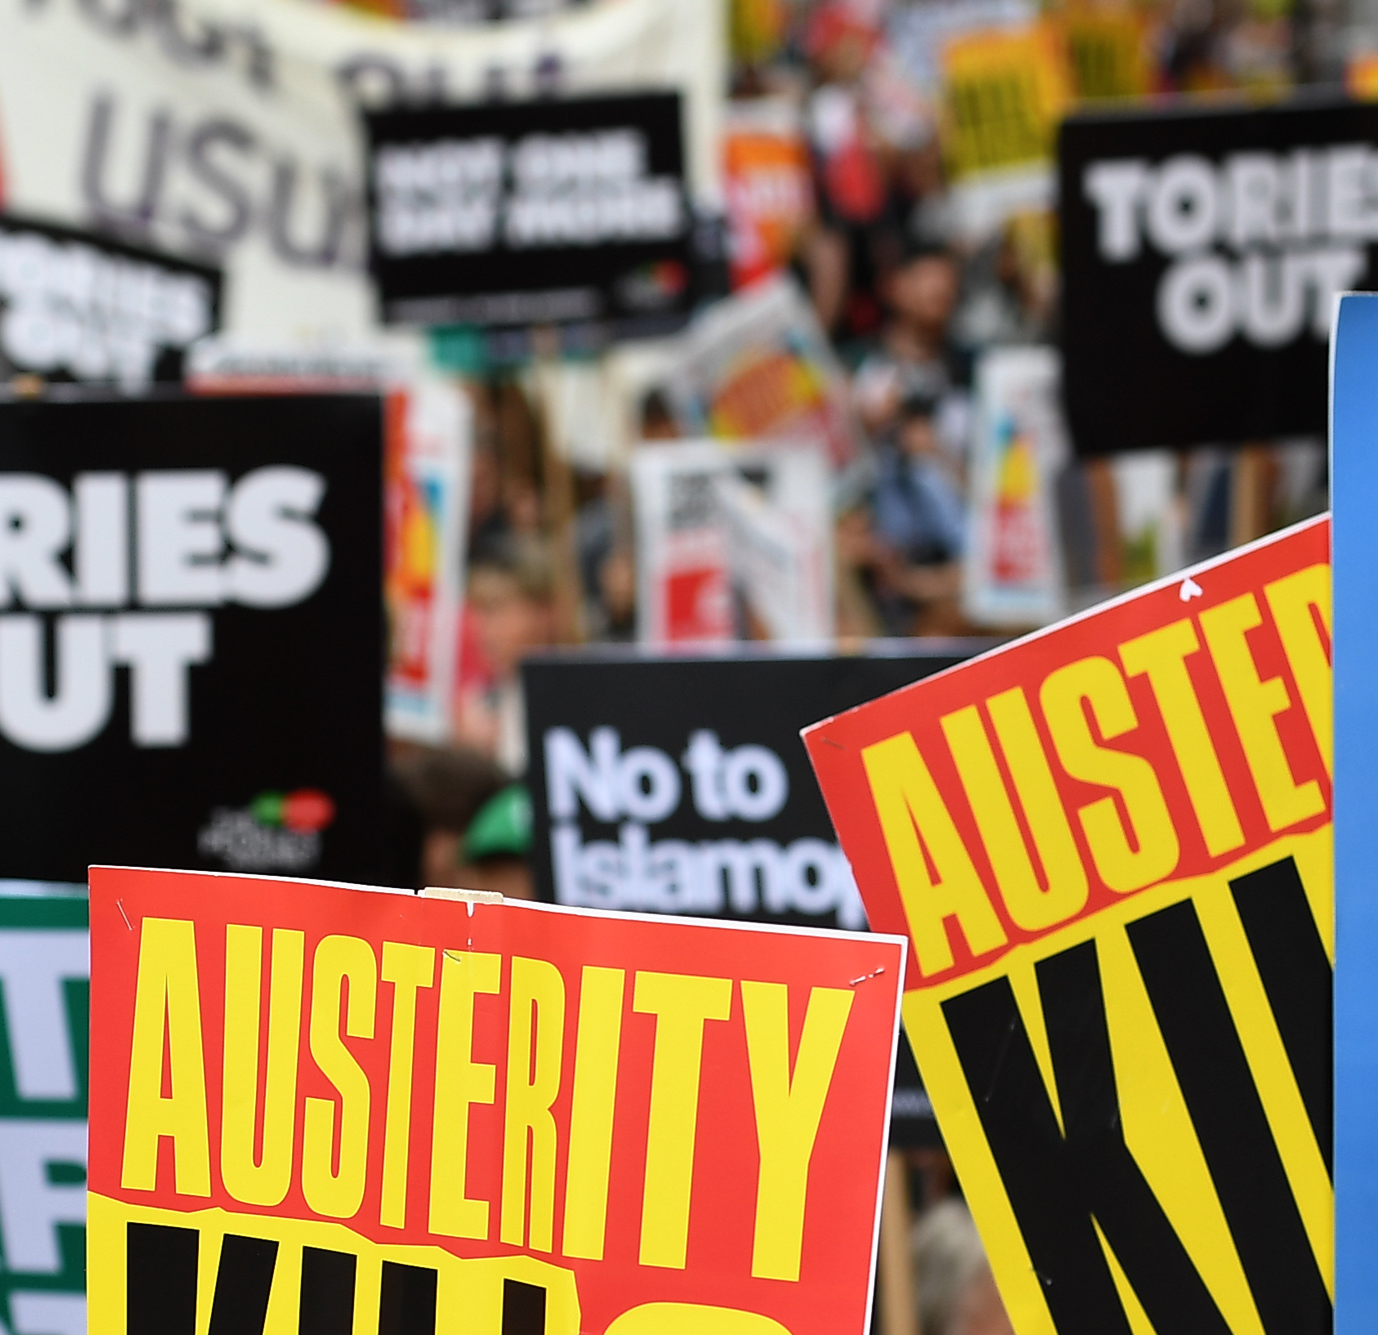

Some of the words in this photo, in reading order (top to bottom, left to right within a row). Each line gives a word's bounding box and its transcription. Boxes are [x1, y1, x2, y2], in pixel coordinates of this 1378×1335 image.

[1155, 243, 1368, 355] OUT
[543, 726, 682, 823] No
[682, 727, 789, 822] to
[121, 916, 855, 1282] AUSTERITY
